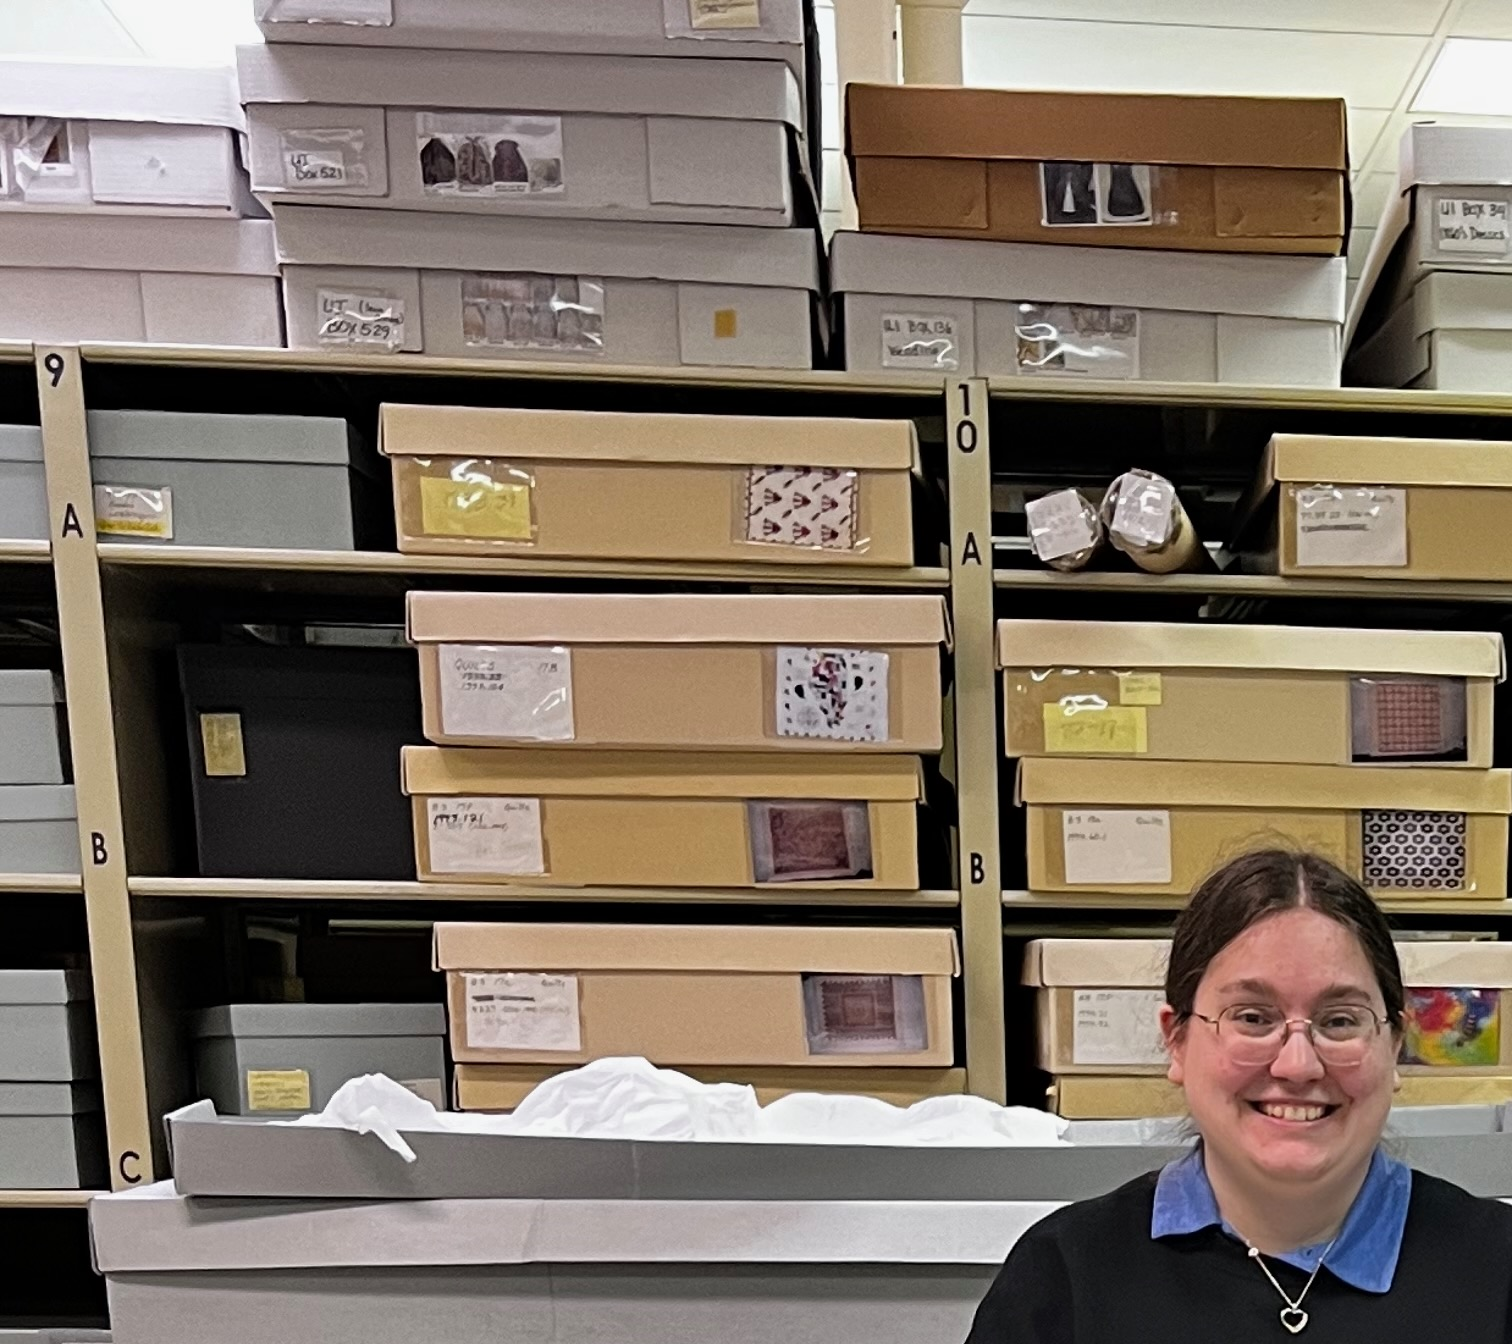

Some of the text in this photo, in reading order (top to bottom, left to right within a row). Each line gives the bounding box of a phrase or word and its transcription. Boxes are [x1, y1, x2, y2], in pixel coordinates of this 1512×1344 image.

[360, 323, 391, 339] 529
[44, 352, 65, 388] 9
[61, 502, 84, 539] A
[961, 531, 982, 566] A
[91, 831, 108, 865] B
[970, 852, 985, 885] B
[119, 1150, 142, 1184] C
